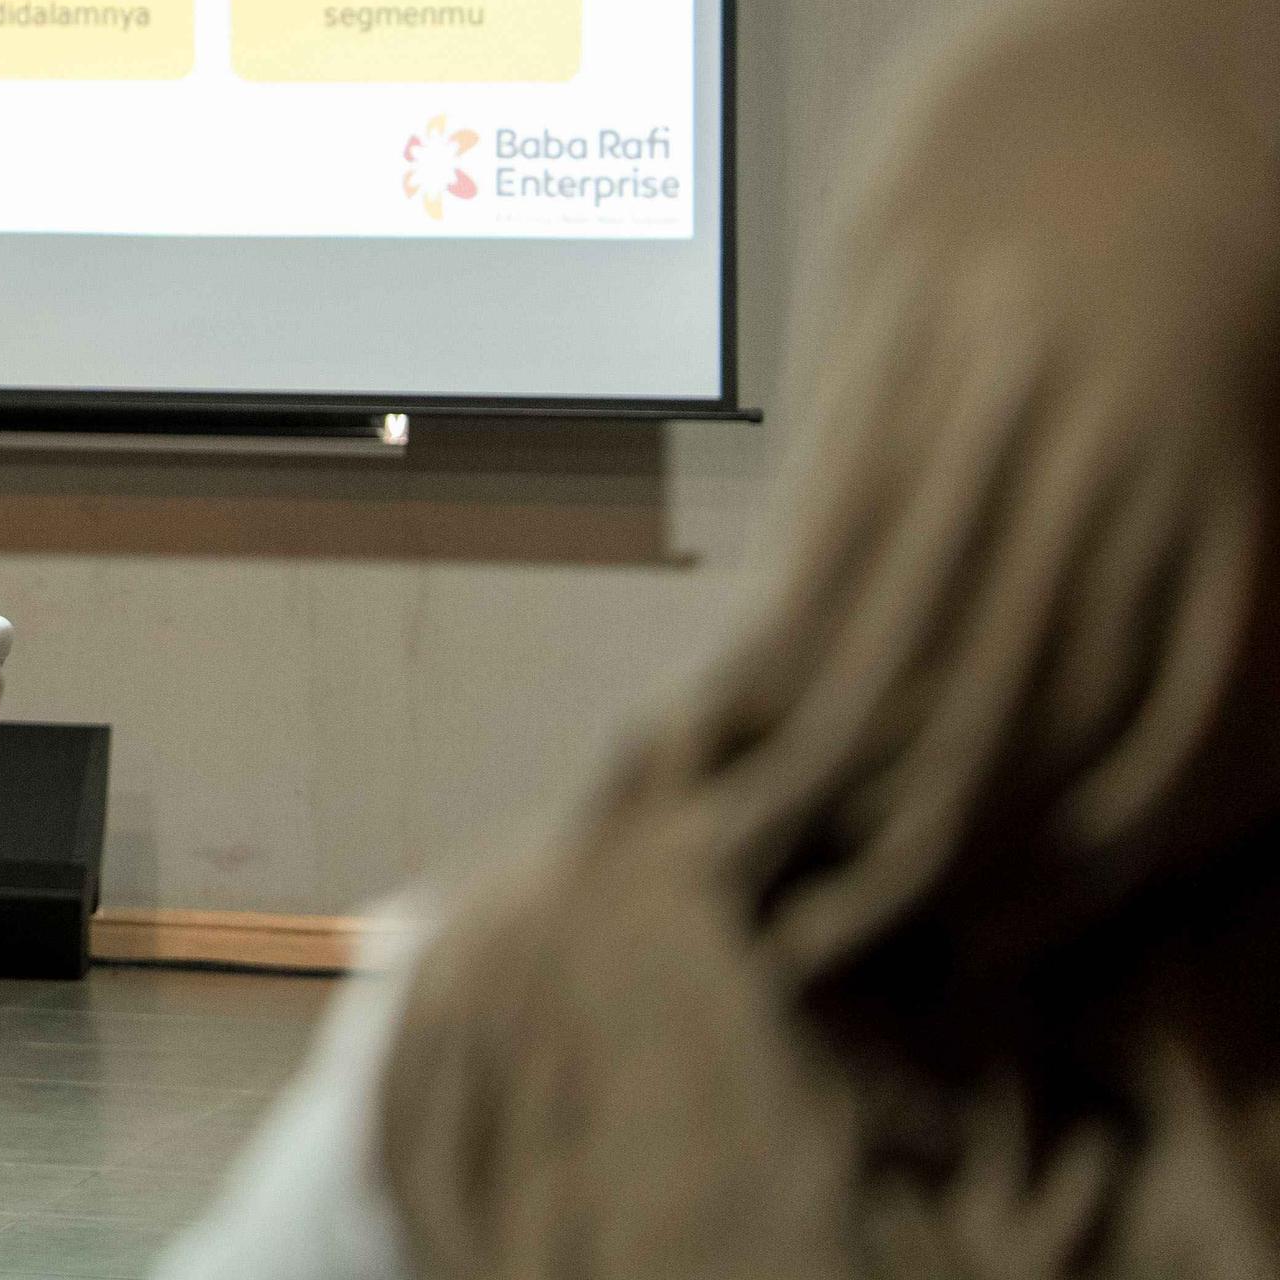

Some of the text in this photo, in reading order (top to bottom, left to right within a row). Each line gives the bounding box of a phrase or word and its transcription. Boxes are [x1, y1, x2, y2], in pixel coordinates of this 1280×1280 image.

[323, 6, 485, 32] segmenmu
[495, 125, 671, 160] Baba Rafi
[495, 167, 680, 208] Enterprise
